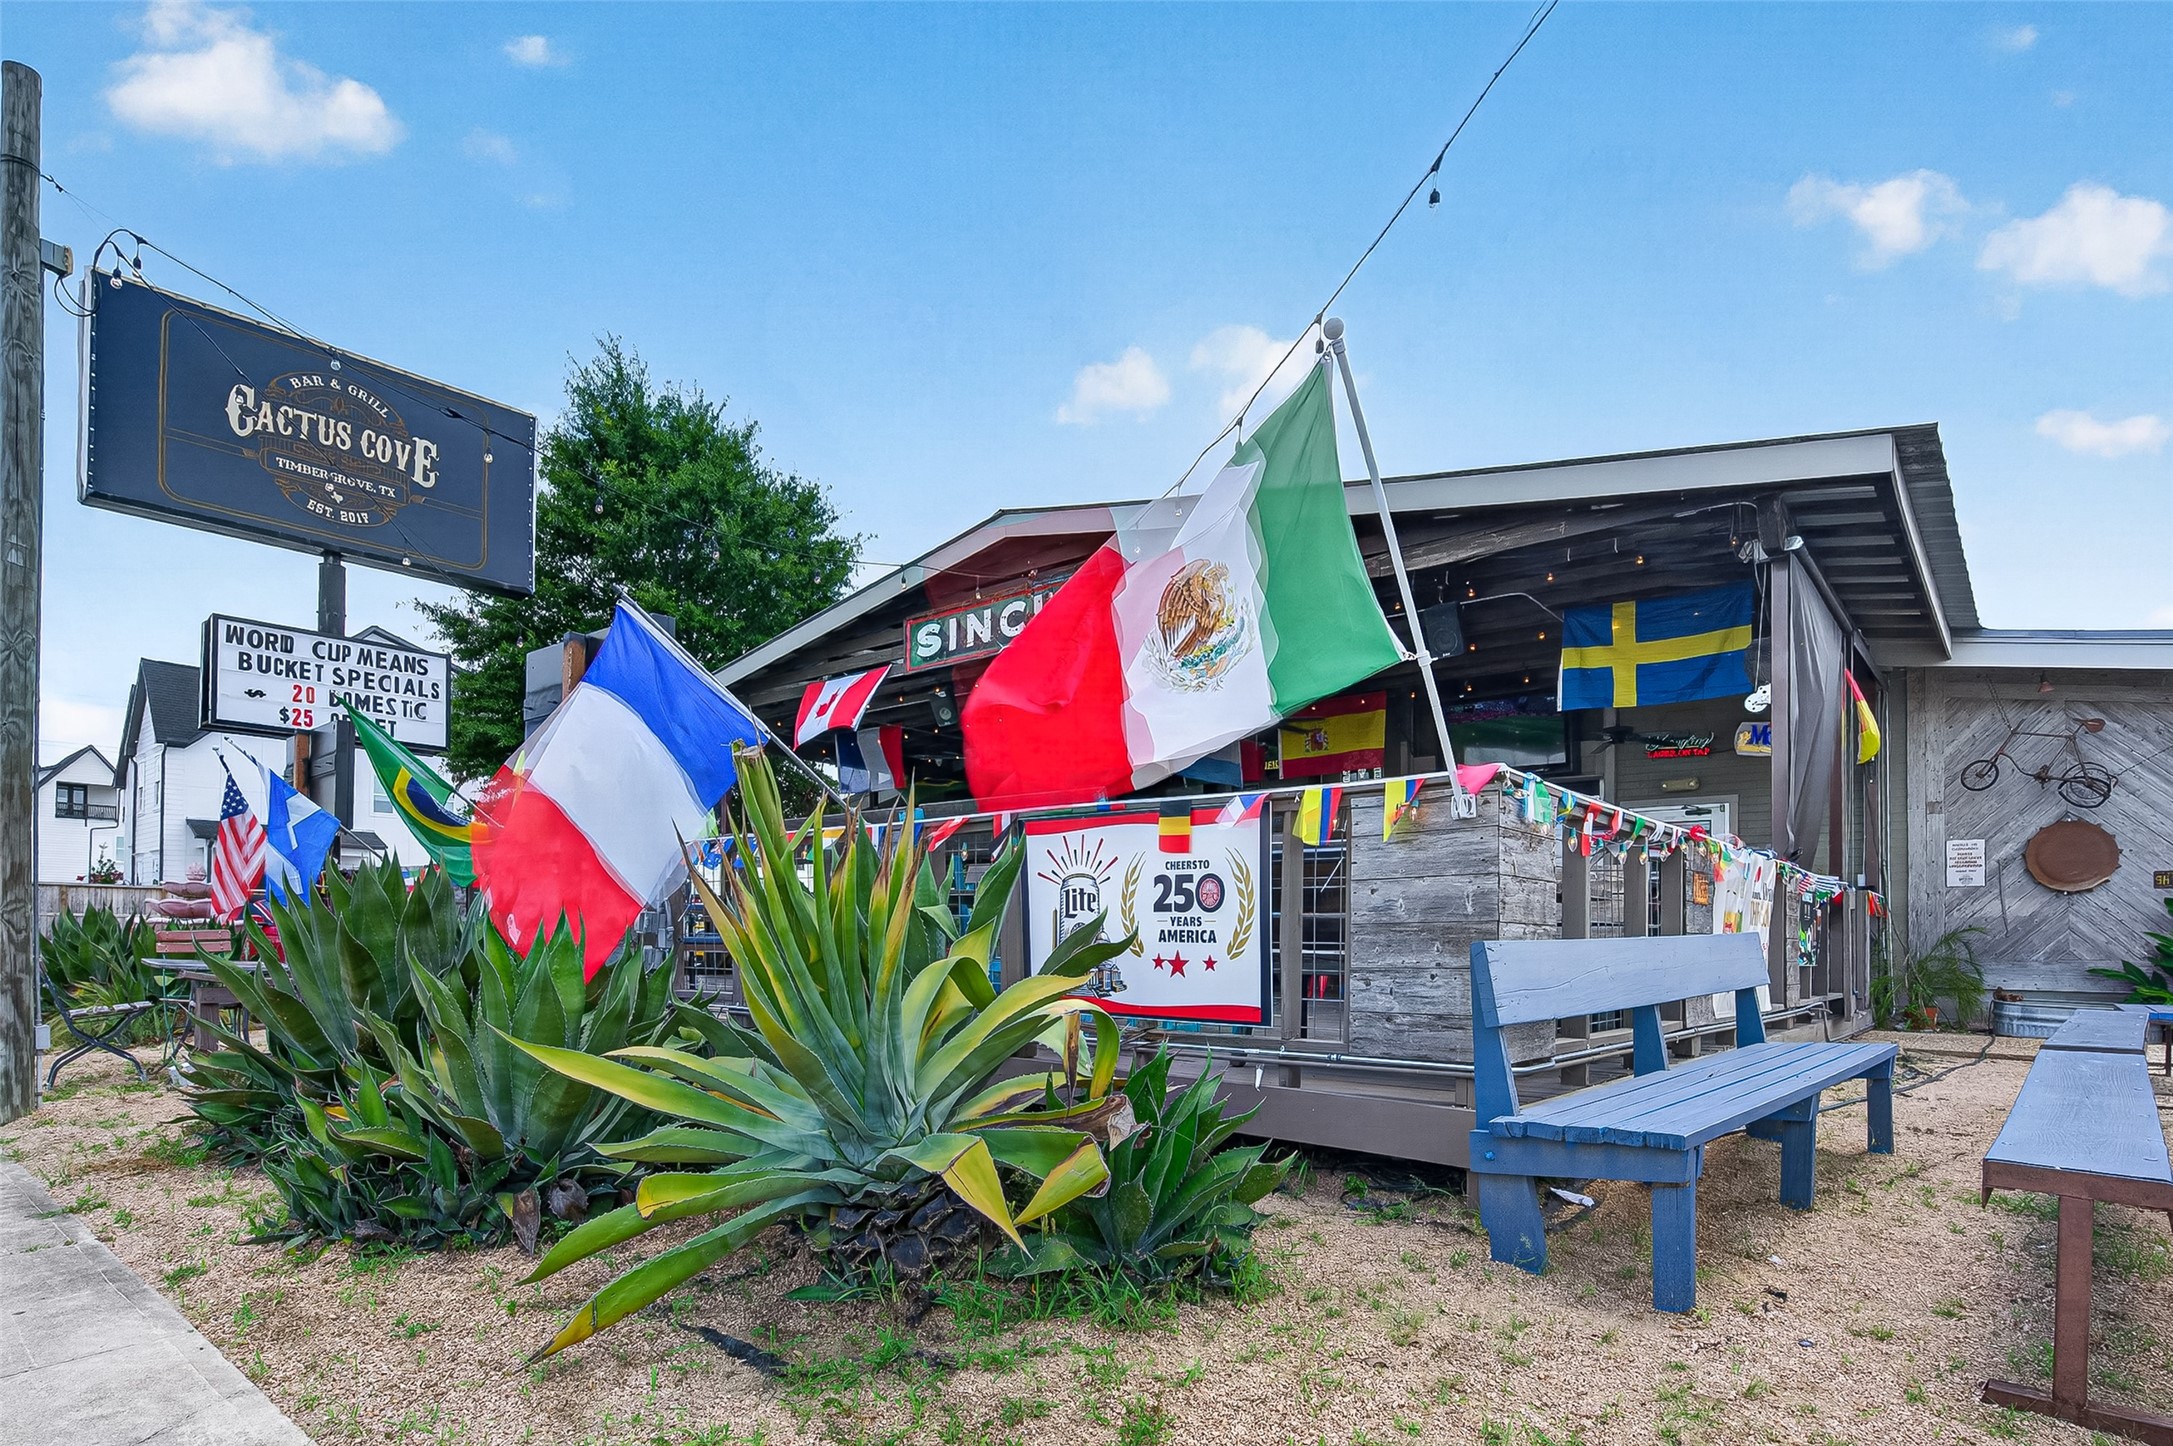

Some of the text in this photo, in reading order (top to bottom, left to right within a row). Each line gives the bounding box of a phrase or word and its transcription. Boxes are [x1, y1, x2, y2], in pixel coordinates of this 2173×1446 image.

[289, 375, 390, 418] BAR & GRILL
[225, 384, 440, 488] CACTUS COVE
[378, 485, 396, 498] TX
[306, 499, 369, 523] EST. 2017
[312, 641, 351, 663] CUP
[356, 647, 429, 676] MEANS
[239, 651, 440, 699] BUCKET SPECIALS
[292, 684, 315, 704] 20
[1063, 888, 1097, 919] Lite
[1153, 873, 1225, 913] 250
[1158, 929, 1217, 944] AMERICA
[1170, 916, 1202, 927] YEARS
